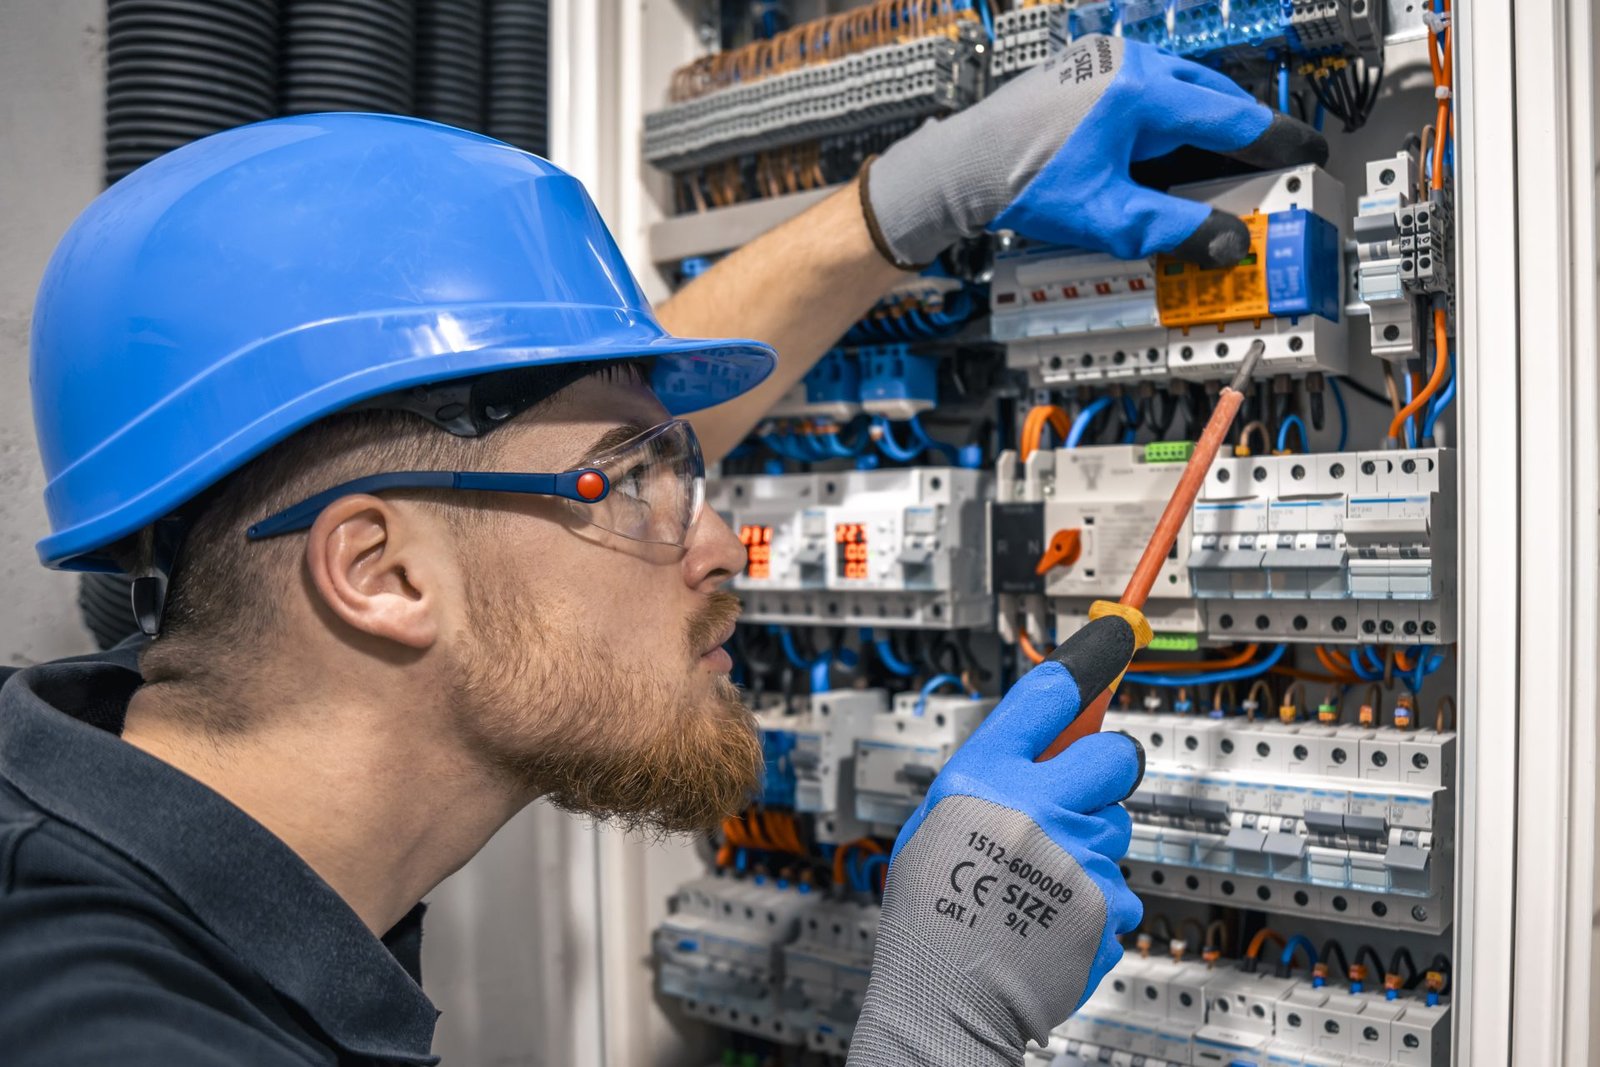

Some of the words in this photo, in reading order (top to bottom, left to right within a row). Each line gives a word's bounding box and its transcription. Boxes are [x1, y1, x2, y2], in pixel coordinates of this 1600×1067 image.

[1074, 52, 1093, 84] SIZE
[951, 861, 998, 907] CE
[968, 831, 1073, 904] 1512-600009
[935, 898, 967, 923] CAT.
[1001, 884, 1058, 929] SIZE
[1004, 912, 1030, 938] 9/L
